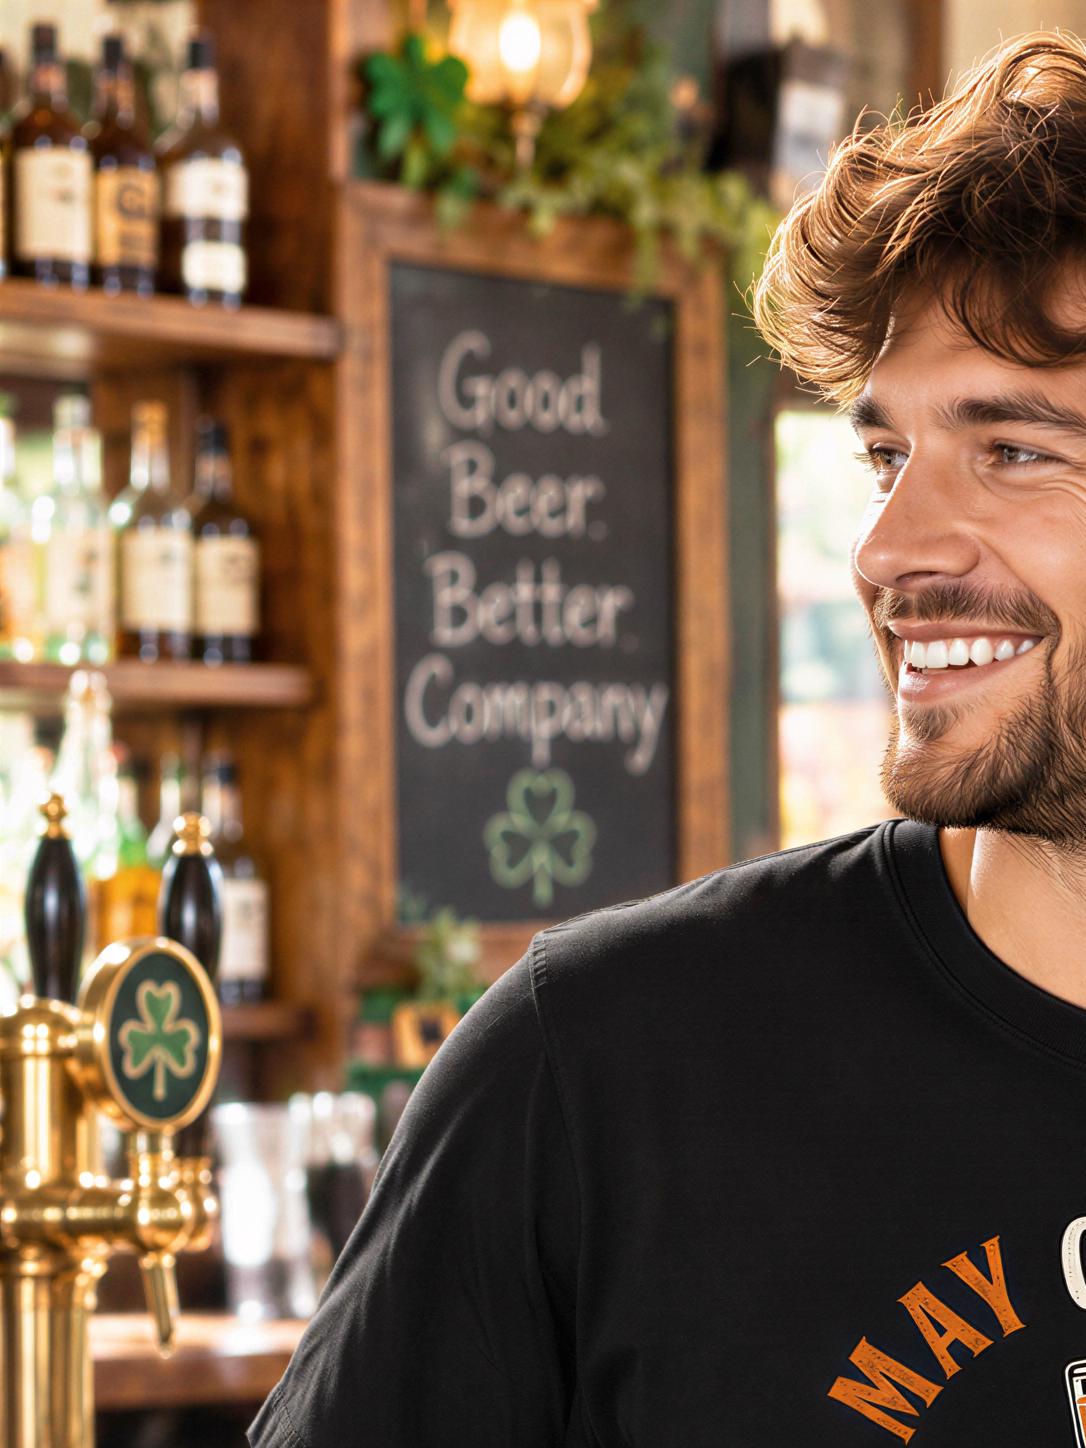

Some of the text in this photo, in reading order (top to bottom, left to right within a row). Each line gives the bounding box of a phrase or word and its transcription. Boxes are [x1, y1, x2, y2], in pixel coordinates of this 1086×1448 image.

[438, 329, 606, 437] Good
[404, 653, 669, 776] Company
[826, 1234, 1026, 1446] MAY
